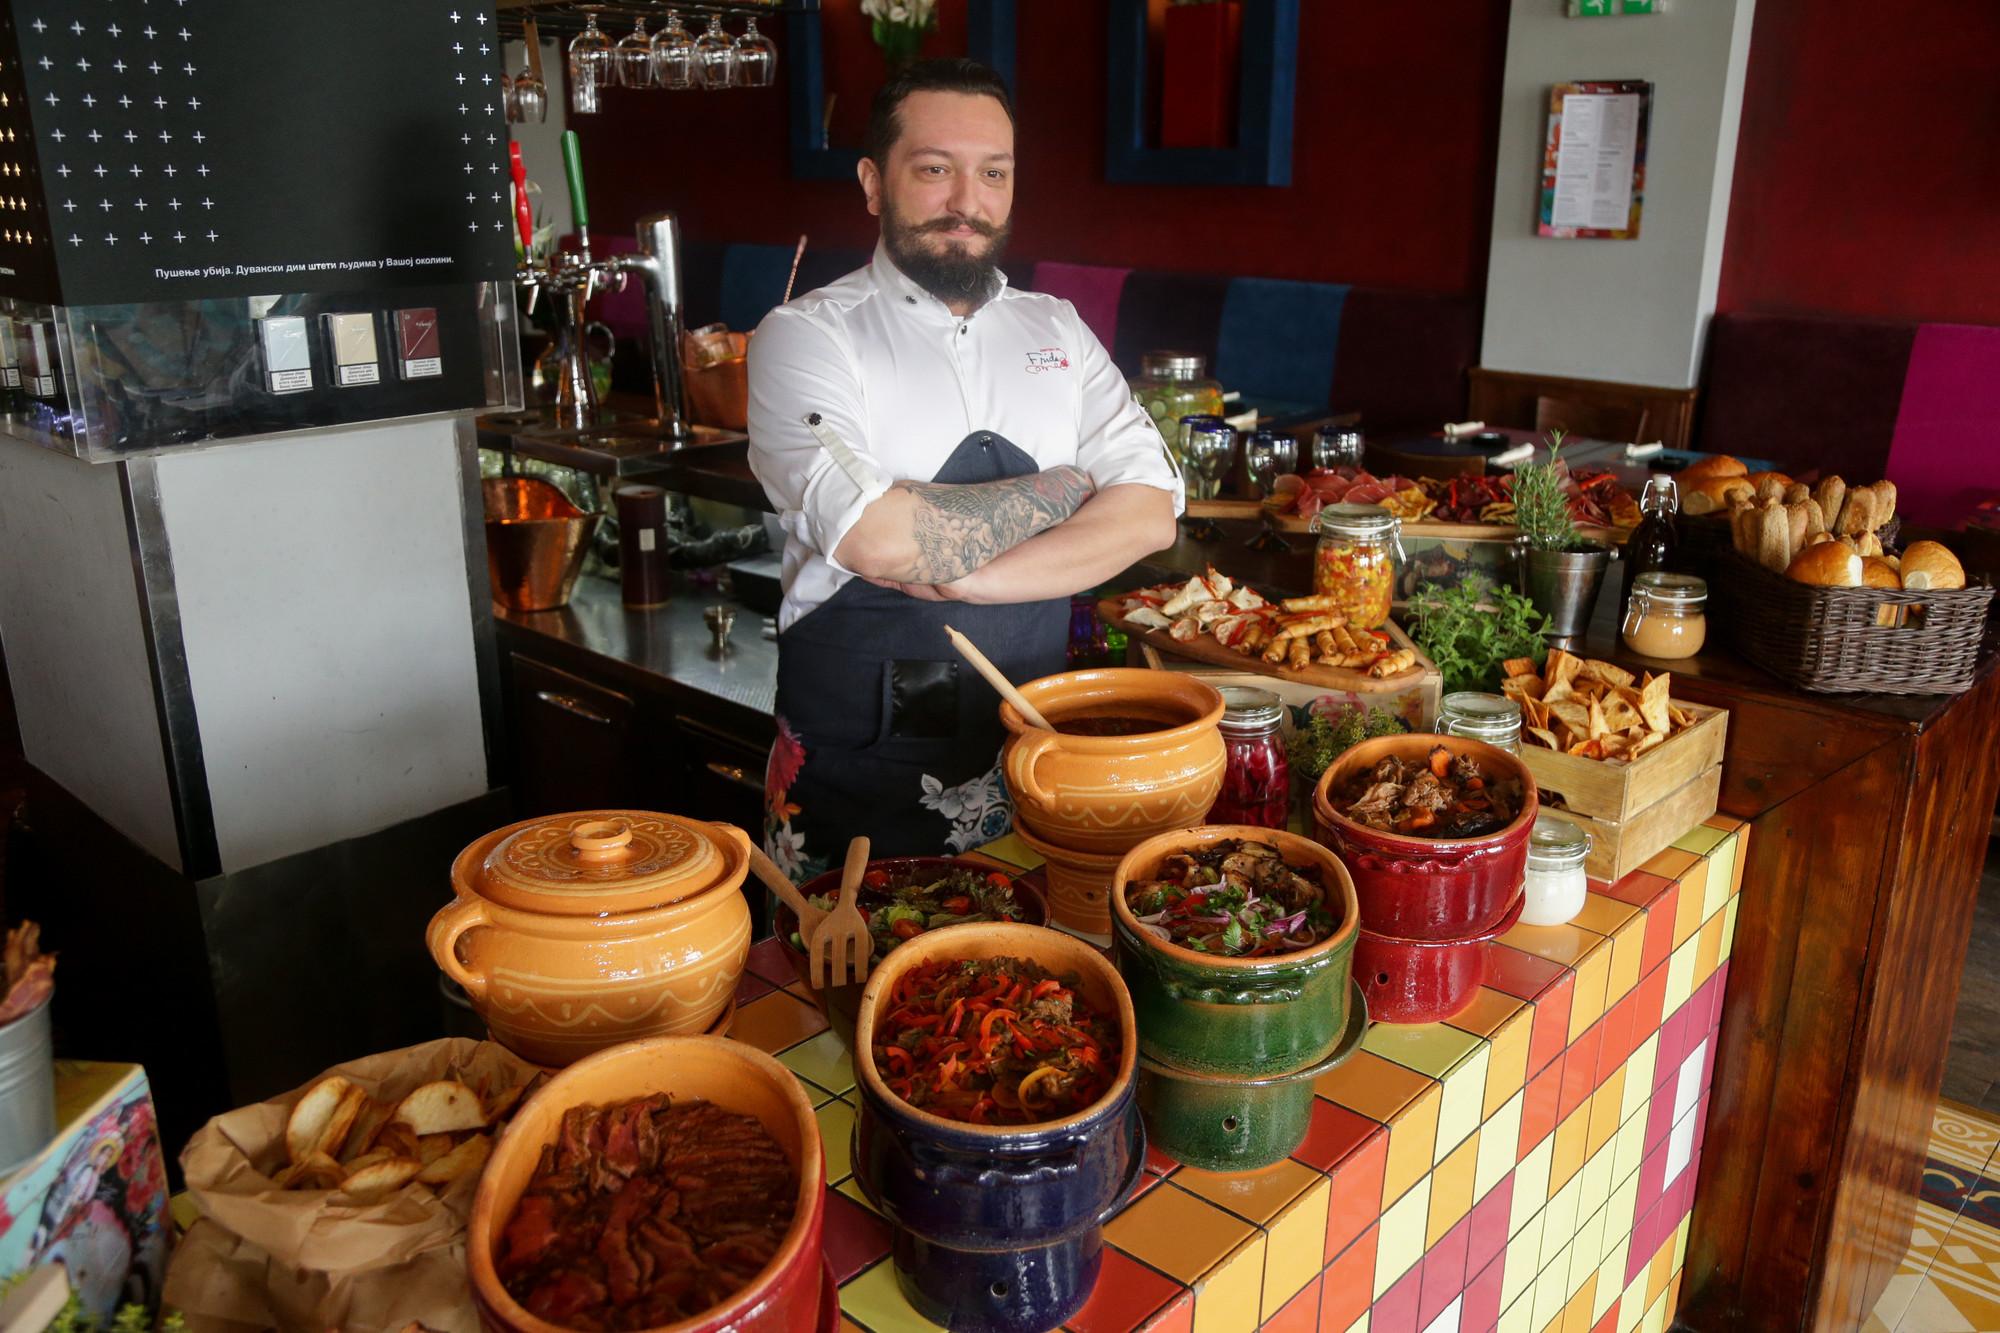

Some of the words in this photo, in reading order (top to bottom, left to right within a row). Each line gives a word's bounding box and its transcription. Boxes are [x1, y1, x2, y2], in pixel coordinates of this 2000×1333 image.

[155, 268, 201, 280] Пушење
[202, 265, 234, 279] убија.
[235, 264, 284, 276] Дувански
[285, 263, 307, 273] дим
[307, 261, 337, 271] штети
[338, 259, 377, 271] људима
[385, 256, 414, 268] Вашој
[414, 256, 454, 265] околини.
[1026, 352, 1059, 364] Frida
